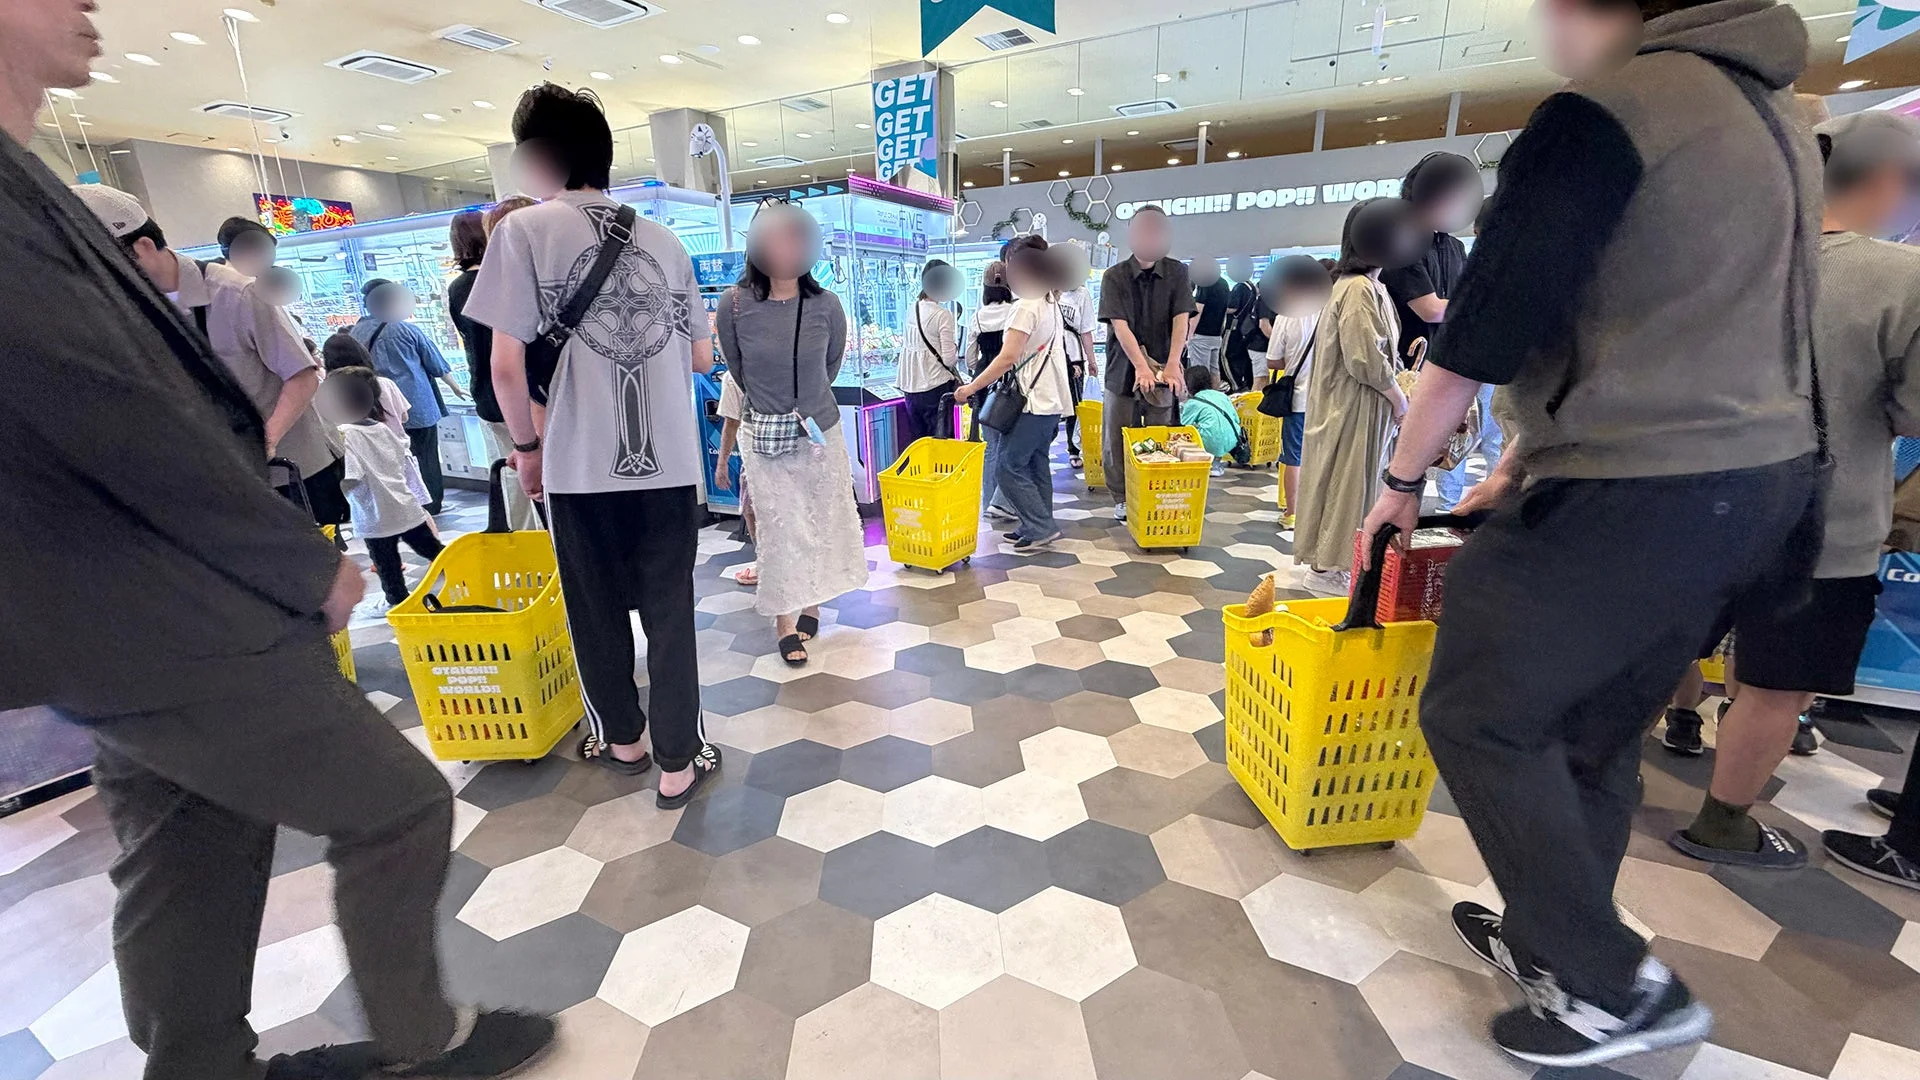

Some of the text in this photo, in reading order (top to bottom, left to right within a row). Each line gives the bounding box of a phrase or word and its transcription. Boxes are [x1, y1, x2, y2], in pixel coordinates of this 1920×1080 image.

[875, 71, 937, 108] GET
[877, 105, 931, 137] GET
[878, 132, 928, 161] GET
[1115, 177, 1406, 220] OICHI!! POP!! WOR
[699, 258, 723, 272] 両替
